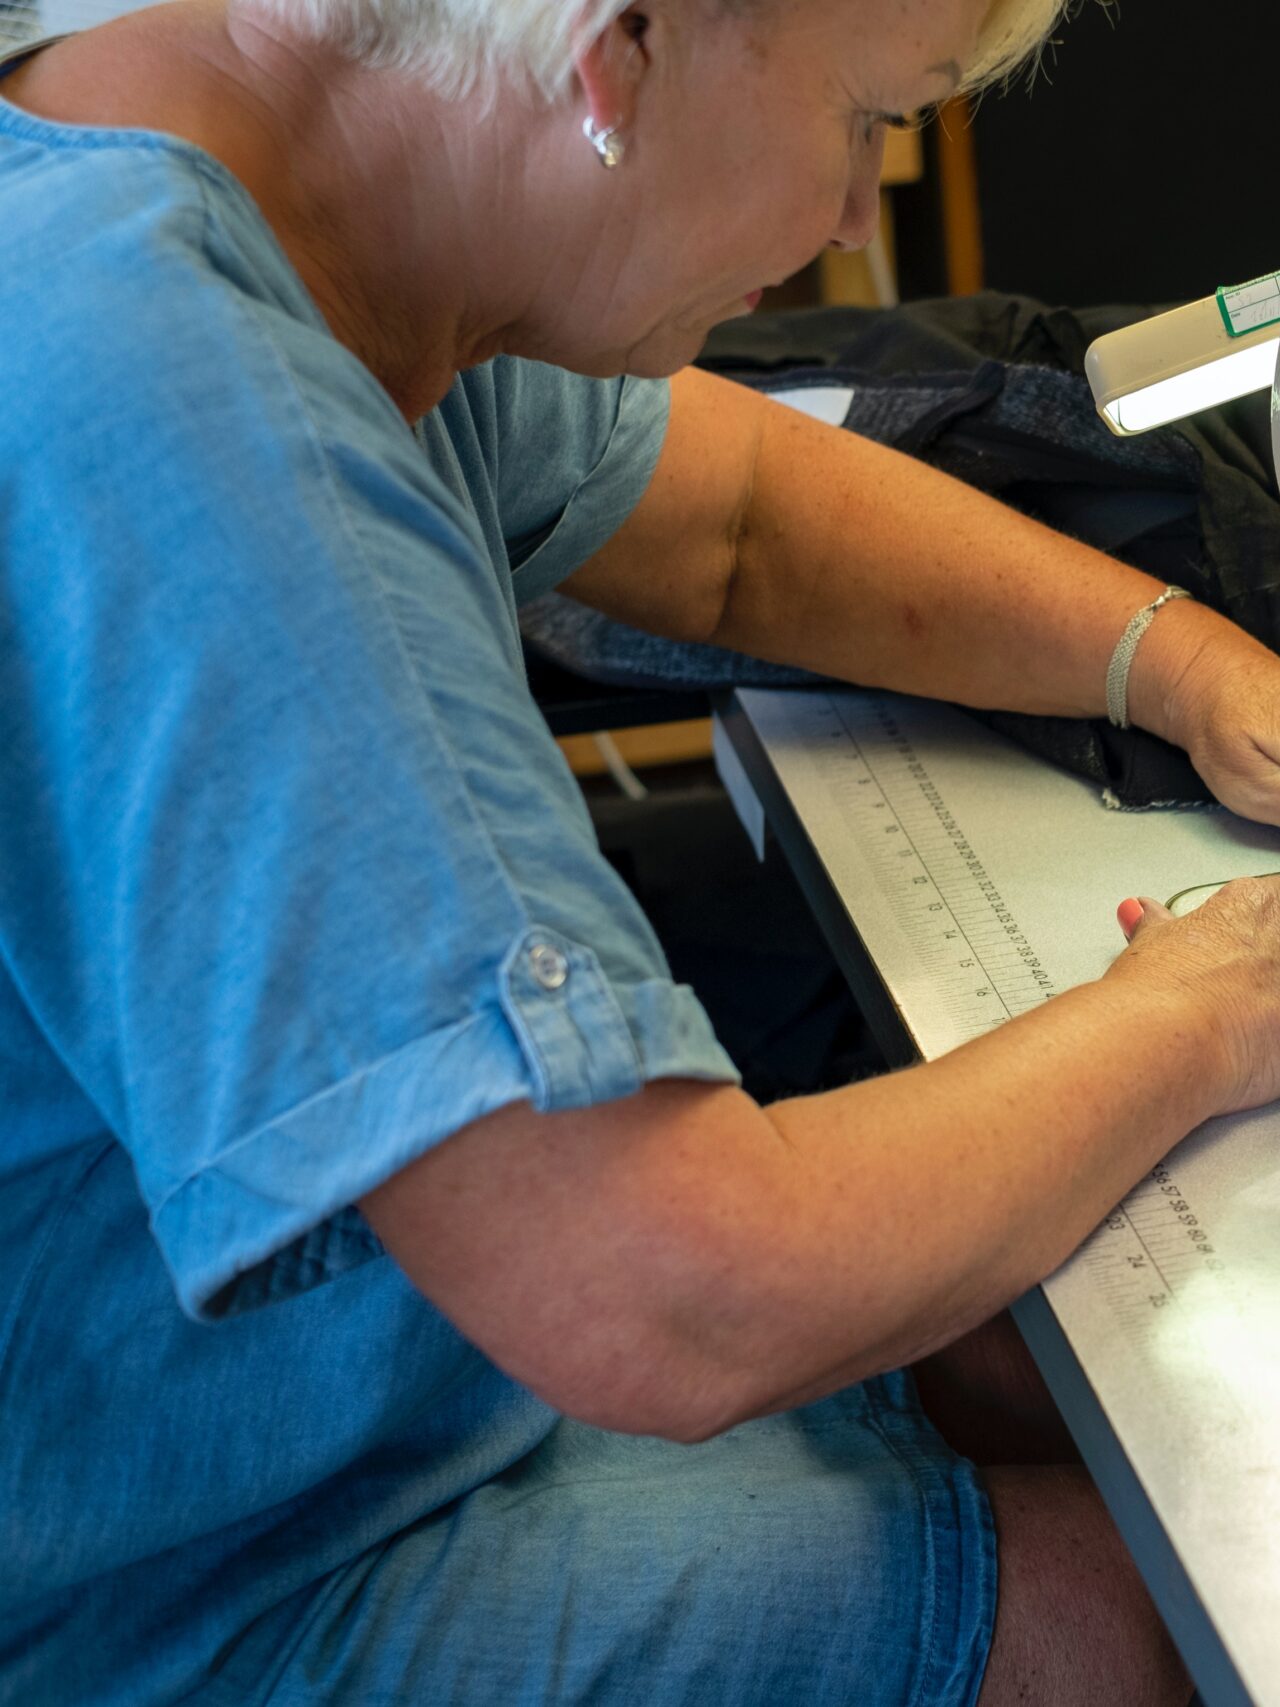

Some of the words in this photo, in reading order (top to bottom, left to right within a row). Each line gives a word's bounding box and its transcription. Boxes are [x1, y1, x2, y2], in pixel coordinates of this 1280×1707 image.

[966, 860, 983, 870] 30
[972, 870, 988, 880] 31
[978, 880, 995, 891] 32
[984, 891, 1001, 902] 33
[990, 902, 1007, 913] 34
[996, 912, 1014, 923] 35
[1003, 923, 1020, 935] 36
[912, 875, 928, 885] 12
[928, 902, 943, 912] 13
[943, 929, 958, 940] 14
[958, 958, 975, 968] 15
[974, 986, 993, 997] 16
[1010, 934, 1028, 944] 37
[1016, 945, 1034, 957] 38
[1023, 957, 1041, 968] 39
[1032, 969, 1048, 980] 40
[1038, 980, 1054, 990] 41
[1160, 1185, 1182, 1197] 57
[1169, 1199, 1190, 1213] 58
[1177, 1213, 1199, 1226] 59
[1186, 1228, 1208, 1242] 60
[1107, 1216, 1126, 1231] 23
[1127, 1253, 1148, 1269] 24
[1149, 1292, 1170, 1309] 25
